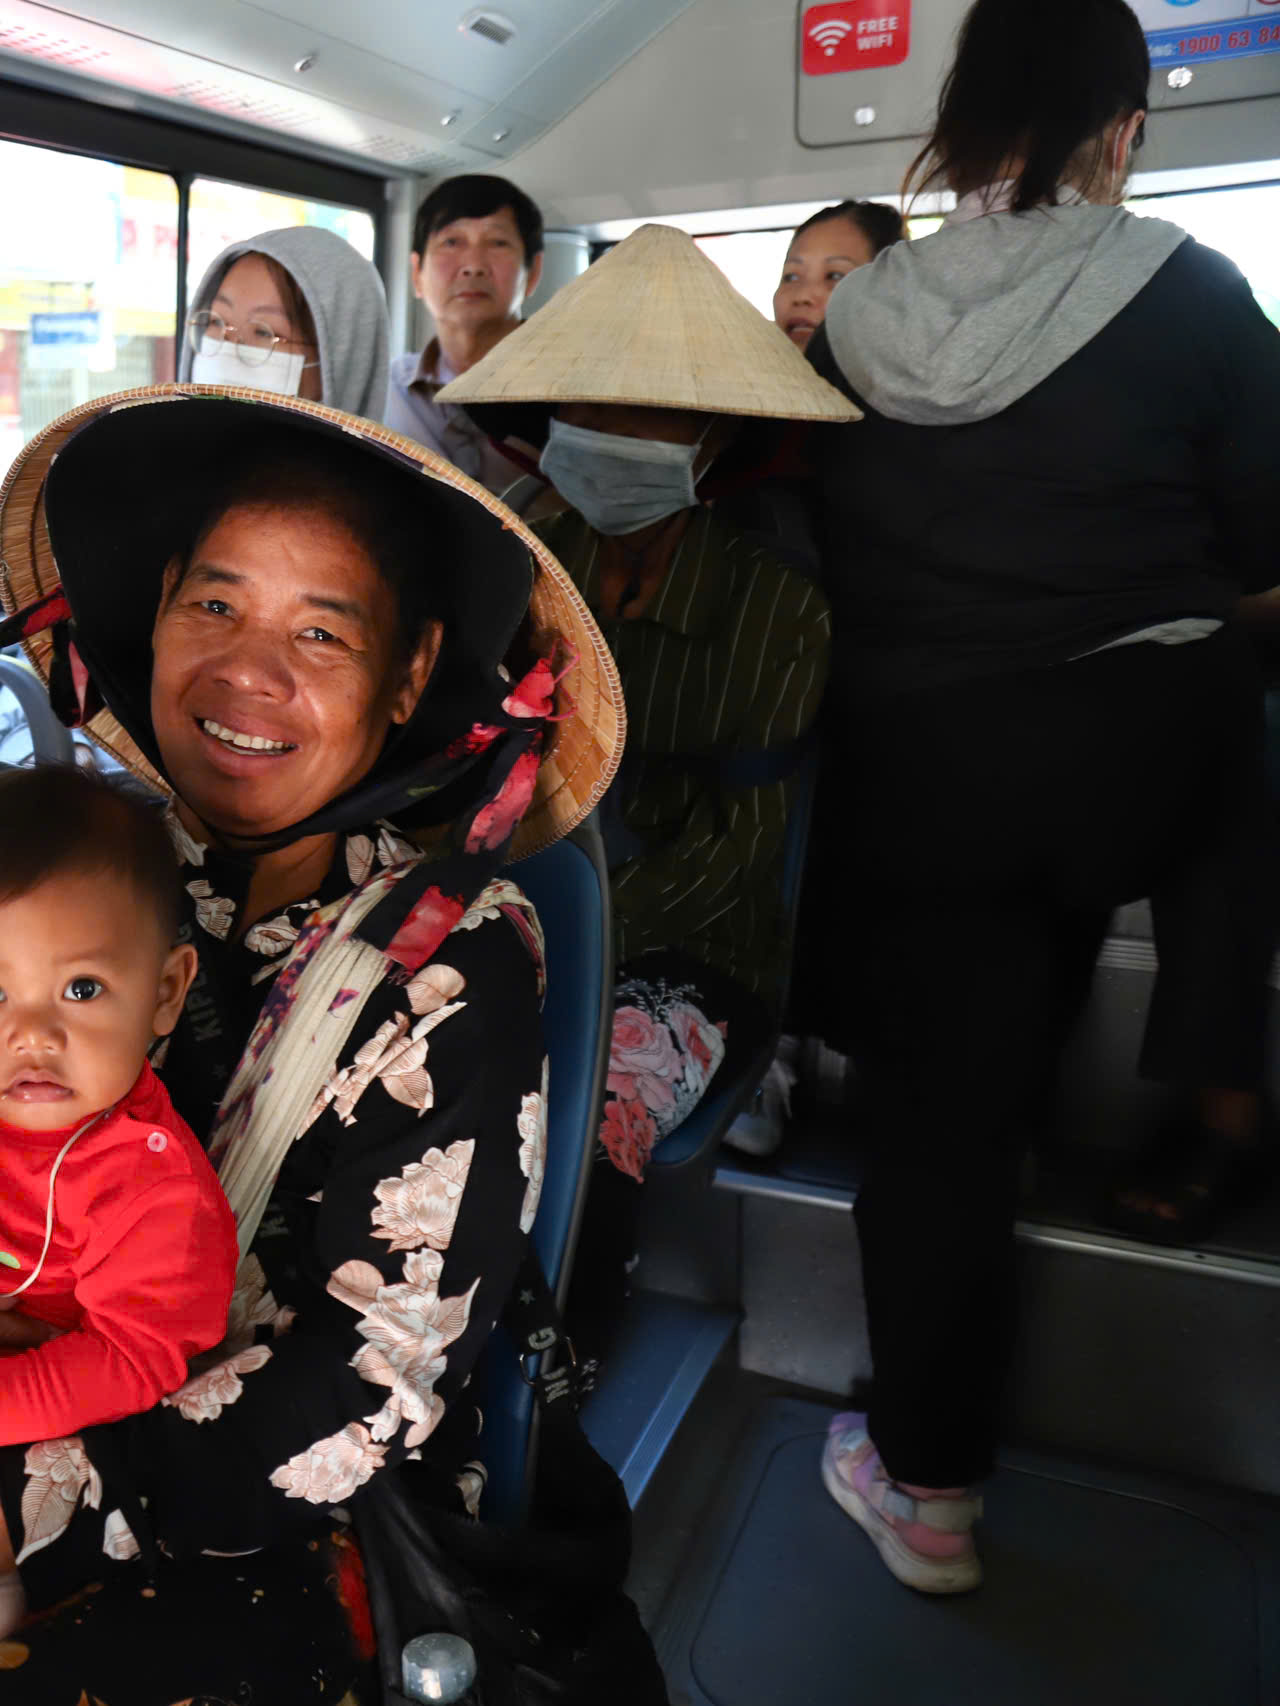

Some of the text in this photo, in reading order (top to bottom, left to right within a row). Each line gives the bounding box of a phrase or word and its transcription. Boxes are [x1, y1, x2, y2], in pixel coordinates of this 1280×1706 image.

[857, 16, 899, 34] FREE
[857, 33, 894, 51] WIFI
[1178, 34, 1221, 56] 1900
[1228, 29, 1251, 49] 63
